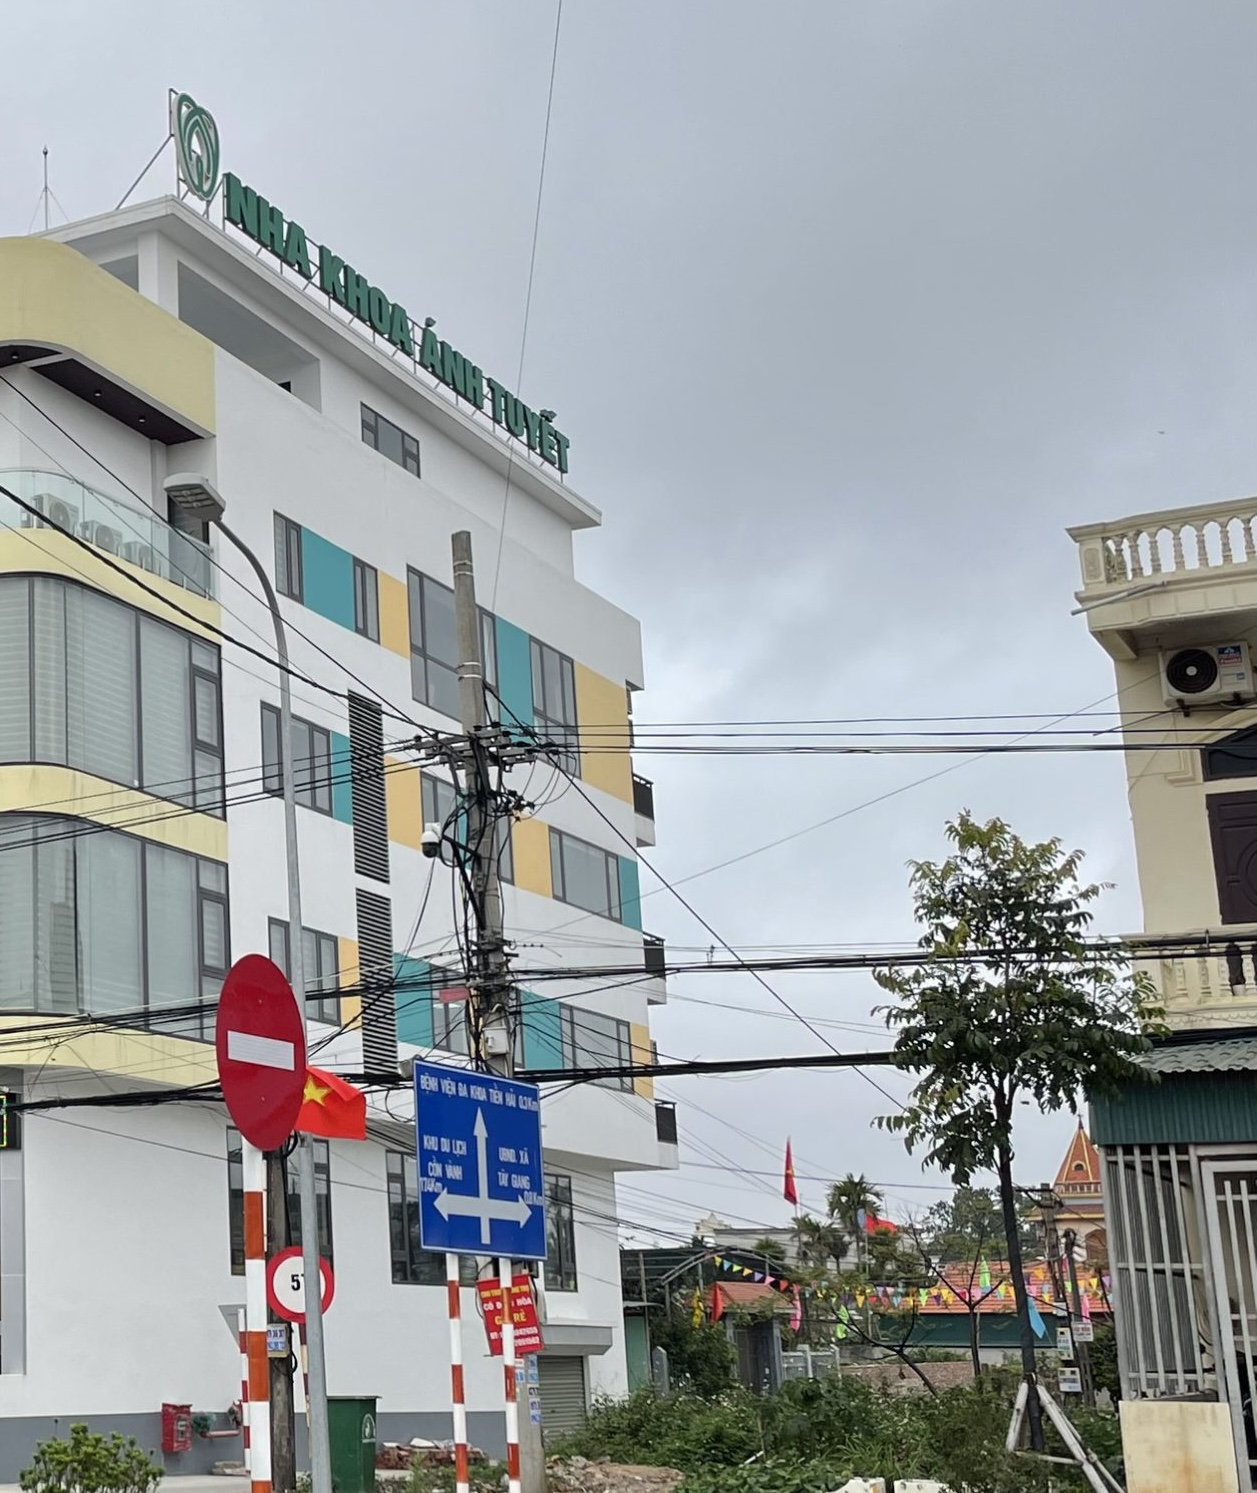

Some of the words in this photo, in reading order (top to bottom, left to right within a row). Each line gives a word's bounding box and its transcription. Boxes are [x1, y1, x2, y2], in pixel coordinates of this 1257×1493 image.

[224, 172, 312, 279] NHA
[318, 245, 414, 357] KHOA
[419, 316, 484, 410] ÁNH
[487, 377, 570, 474] TUYẾT
[420, 1073, 439, 1094] BỆNH
[440, 1077, 456, 1098] VIỆN
[470, 1085, 487, 1102] KHOA
[488, 1082, 504, 1105] TIỀN
[424, 1134, 438, 1151] KHU
[440, 1137, 450, 1153] DU
[452, 1140, 467, 1157] LỊCH
[519, 1148, 529, 1165] XÃ
[445, 1160, 463, 1180] VÀNH
[510, 1174, 530, 1190] GIANG
